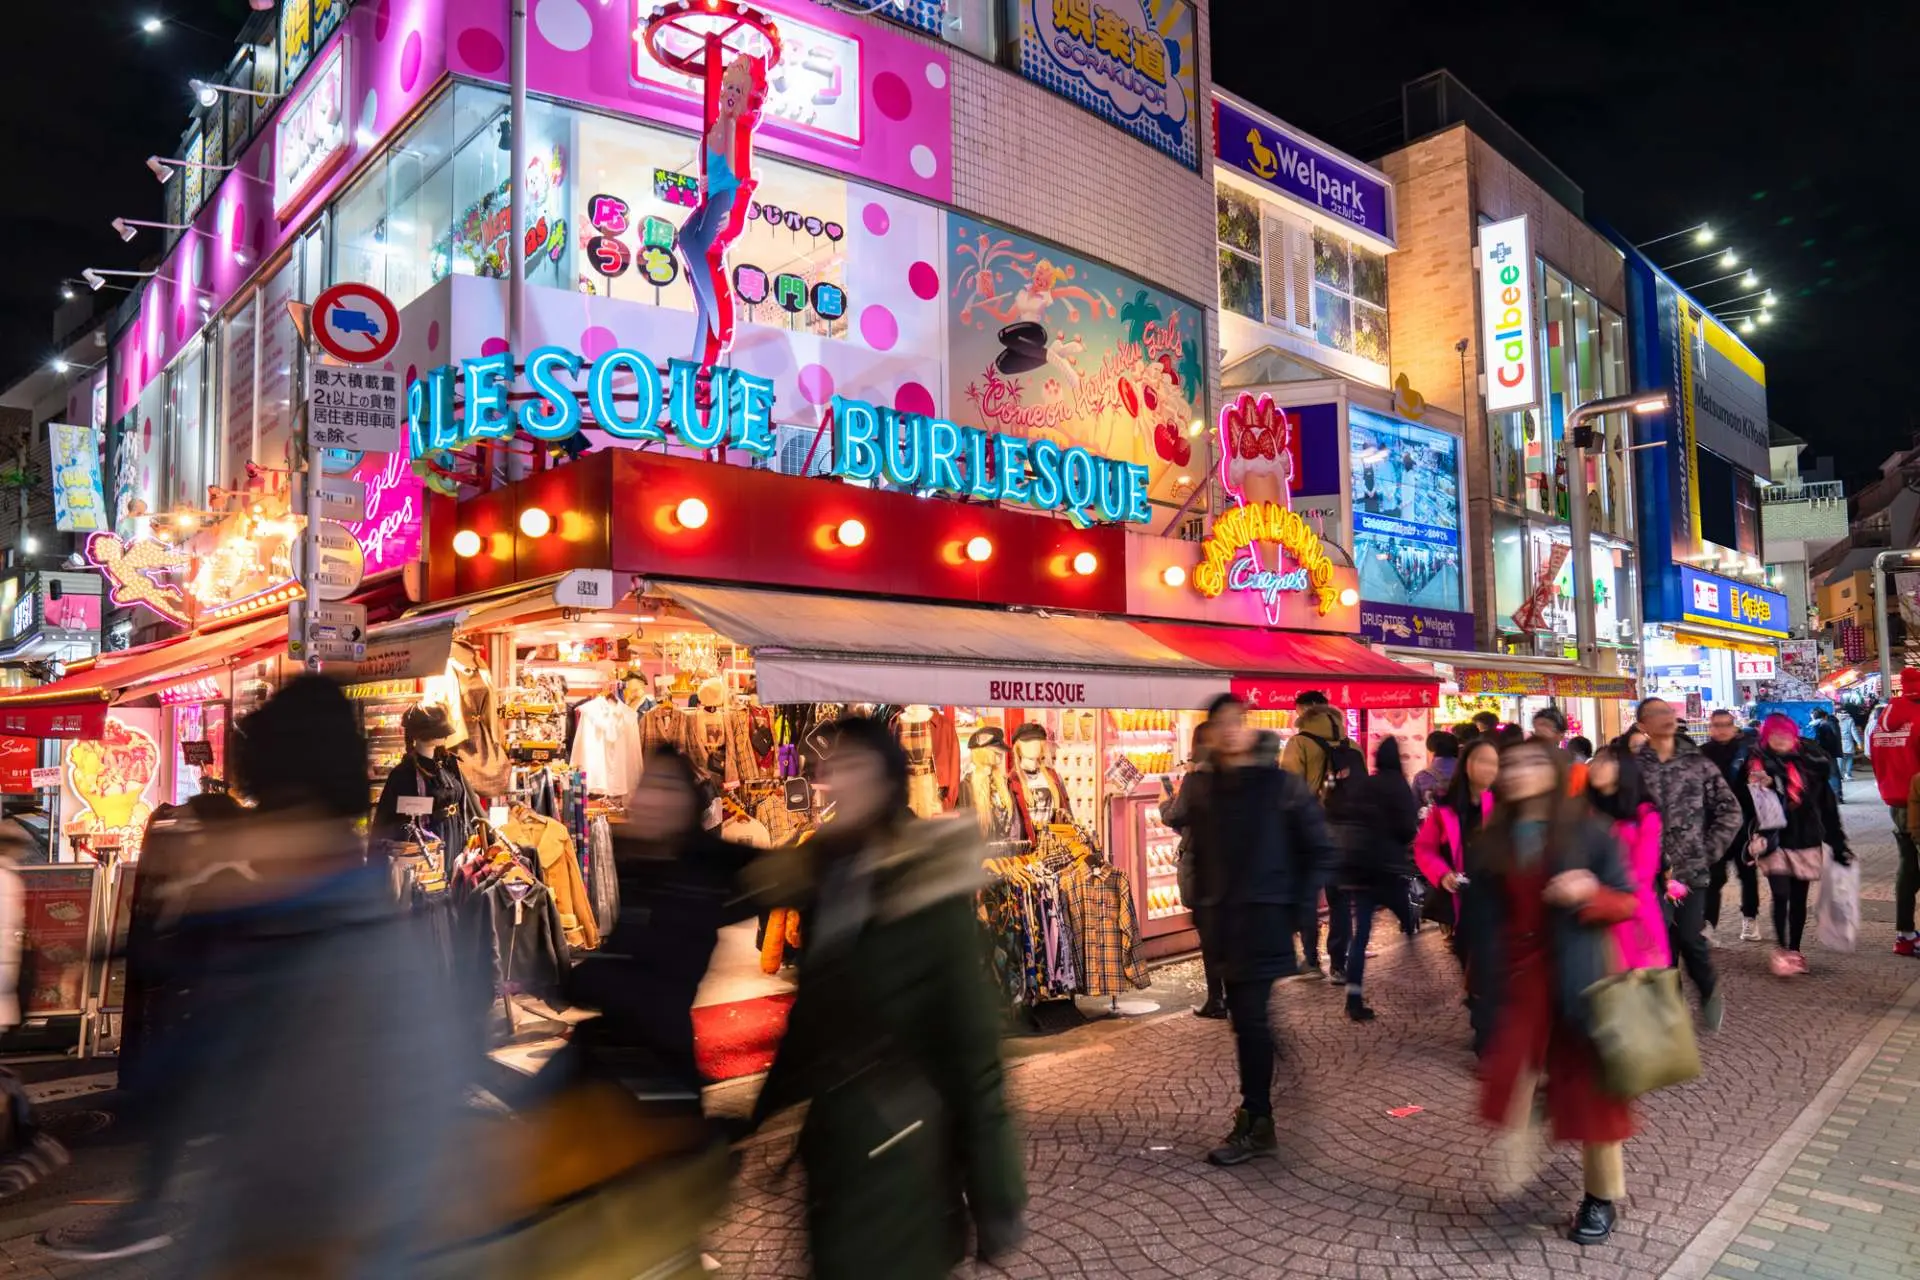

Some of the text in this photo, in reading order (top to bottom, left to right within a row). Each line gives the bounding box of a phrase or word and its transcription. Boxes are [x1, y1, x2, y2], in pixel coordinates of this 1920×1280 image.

[1054, 36, 1168, 111] GORAKUDOH
[1276, 142, 1365, 213] Welpark
[1142, 317, 1184, 359] Girls
[1496, 264, 1526, 388] Calbee
[313, 370, 396, 392] 最大積載量
[314, 388, 396, 410] 2t以上の貨物
[314, 407, 396, 430] 居住者用車両
[1695, 382, 1742, 435] Matsumoto
[313, 427, 358, 444] を除く
[831, 394, 1153, 529] BURLESQUE
[1194, 502, 1341, 617] SANTA MONICA
[1229, 556, 1309, 605] Crepes
[1423, 616, 1456, 637] Welpark
[989, 680, 1086, 705] BURLESQUE
